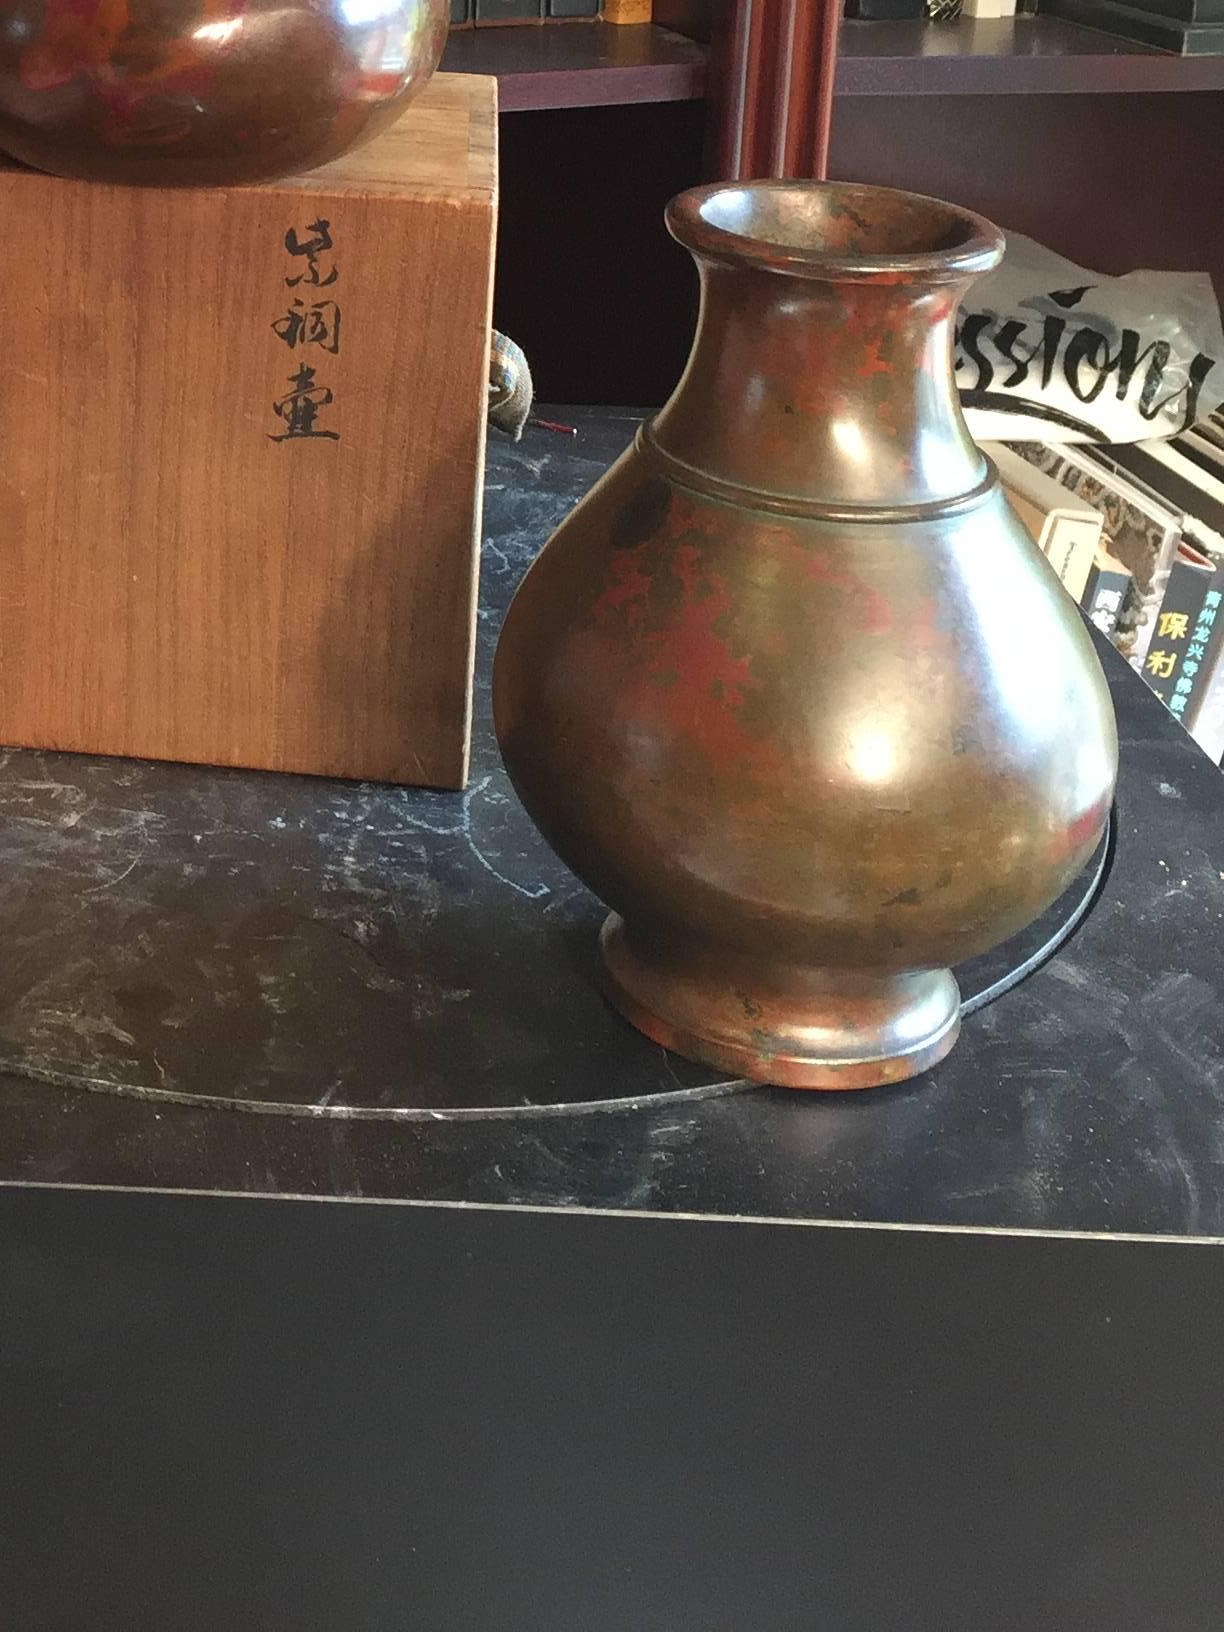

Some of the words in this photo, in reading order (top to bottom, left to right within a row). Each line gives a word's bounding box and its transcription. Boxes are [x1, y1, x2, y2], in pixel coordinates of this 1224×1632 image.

[1146, 611, 1190, 700] 保利
[1168, 590, 1223, 719] 青州龙兴寺佛教
